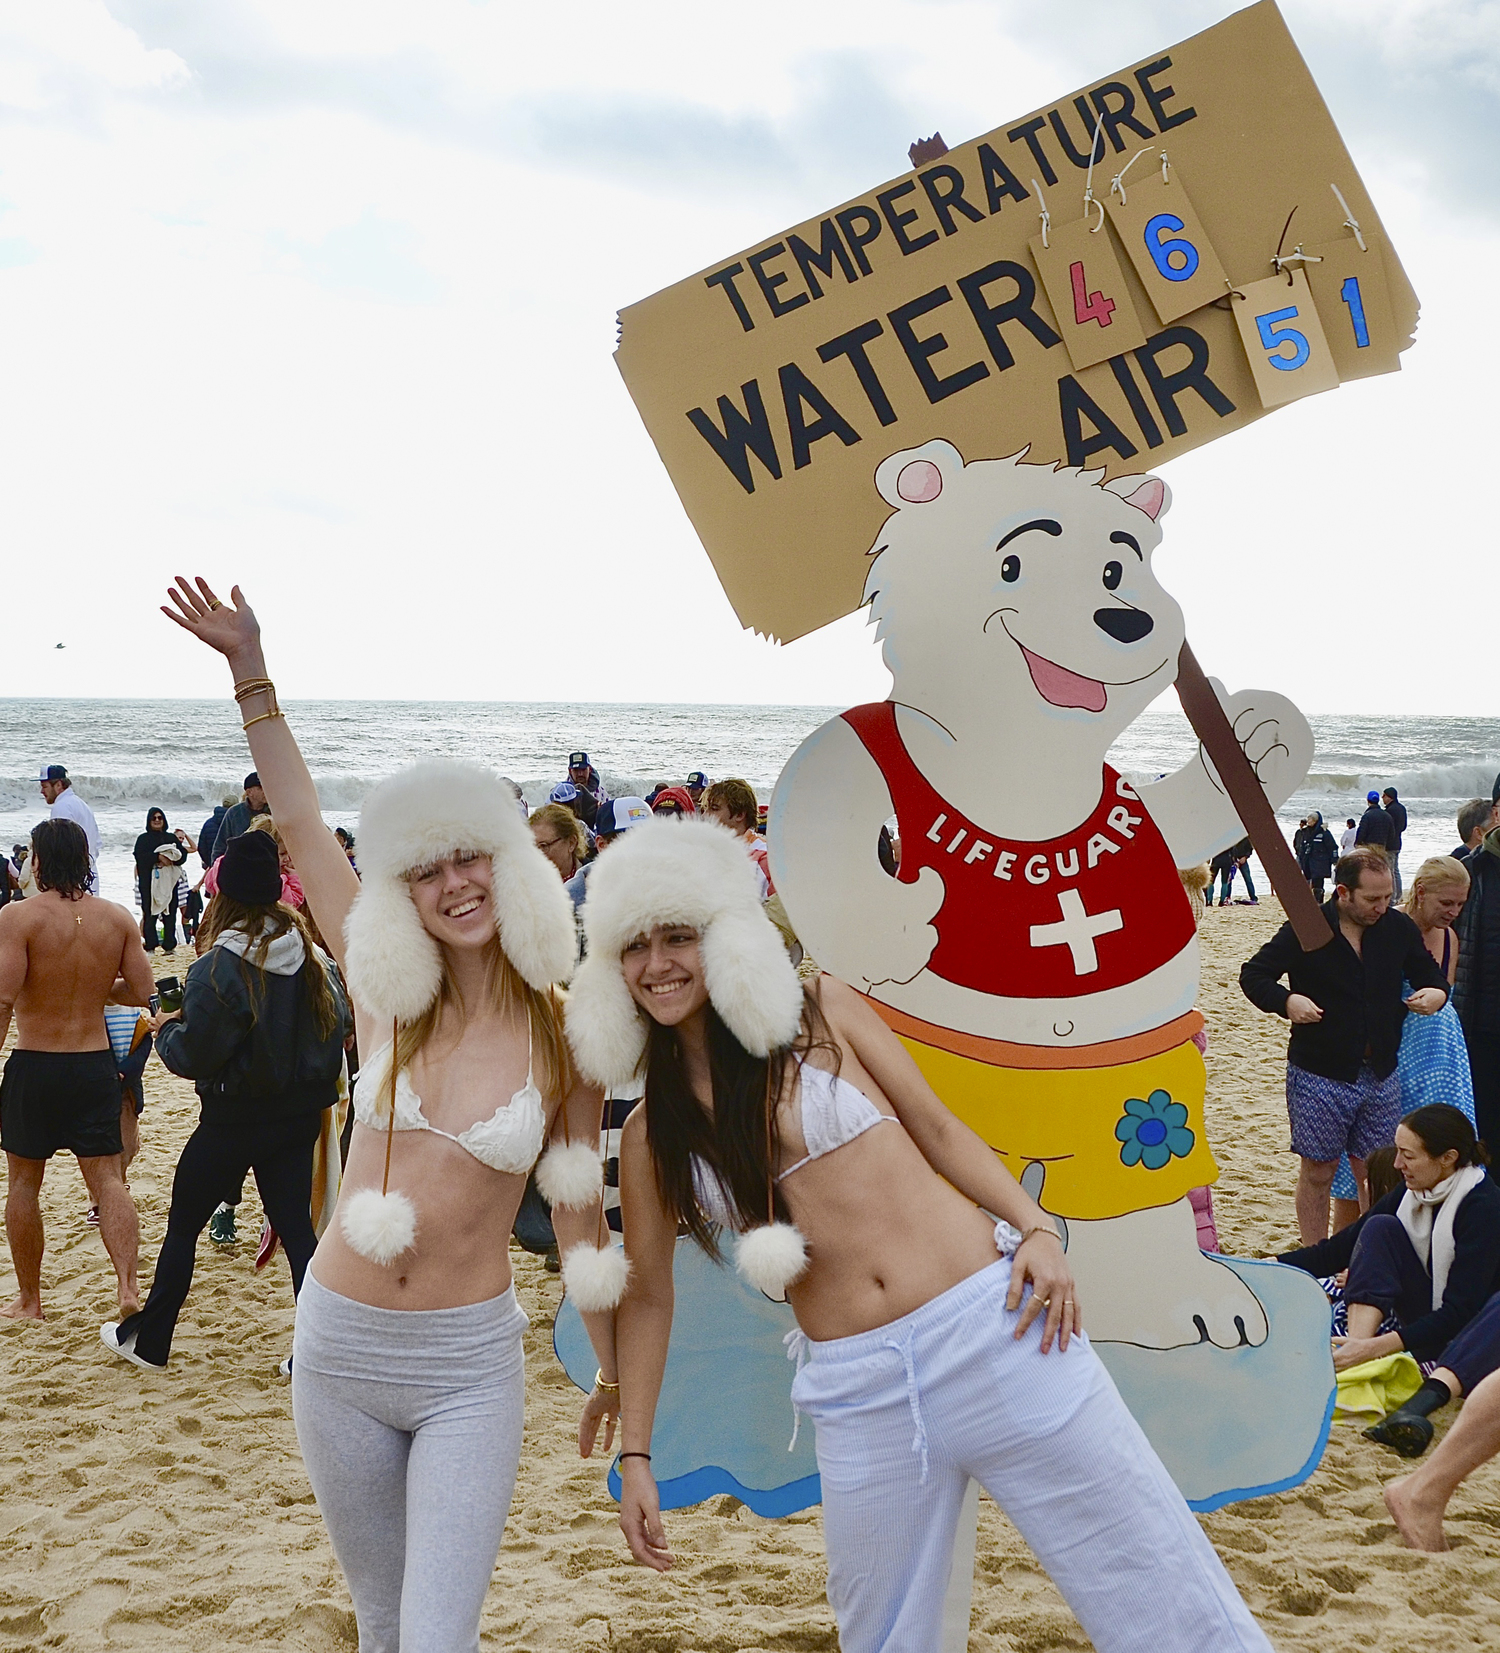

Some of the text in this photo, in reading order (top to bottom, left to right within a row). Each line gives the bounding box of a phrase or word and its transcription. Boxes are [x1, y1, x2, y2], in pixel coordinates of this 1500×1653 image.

[704, 56, 1198, 333] TEMPERATURE
[685, 260, 1064, 494] WATER
[1057, 325, 1237, 466] AIR
